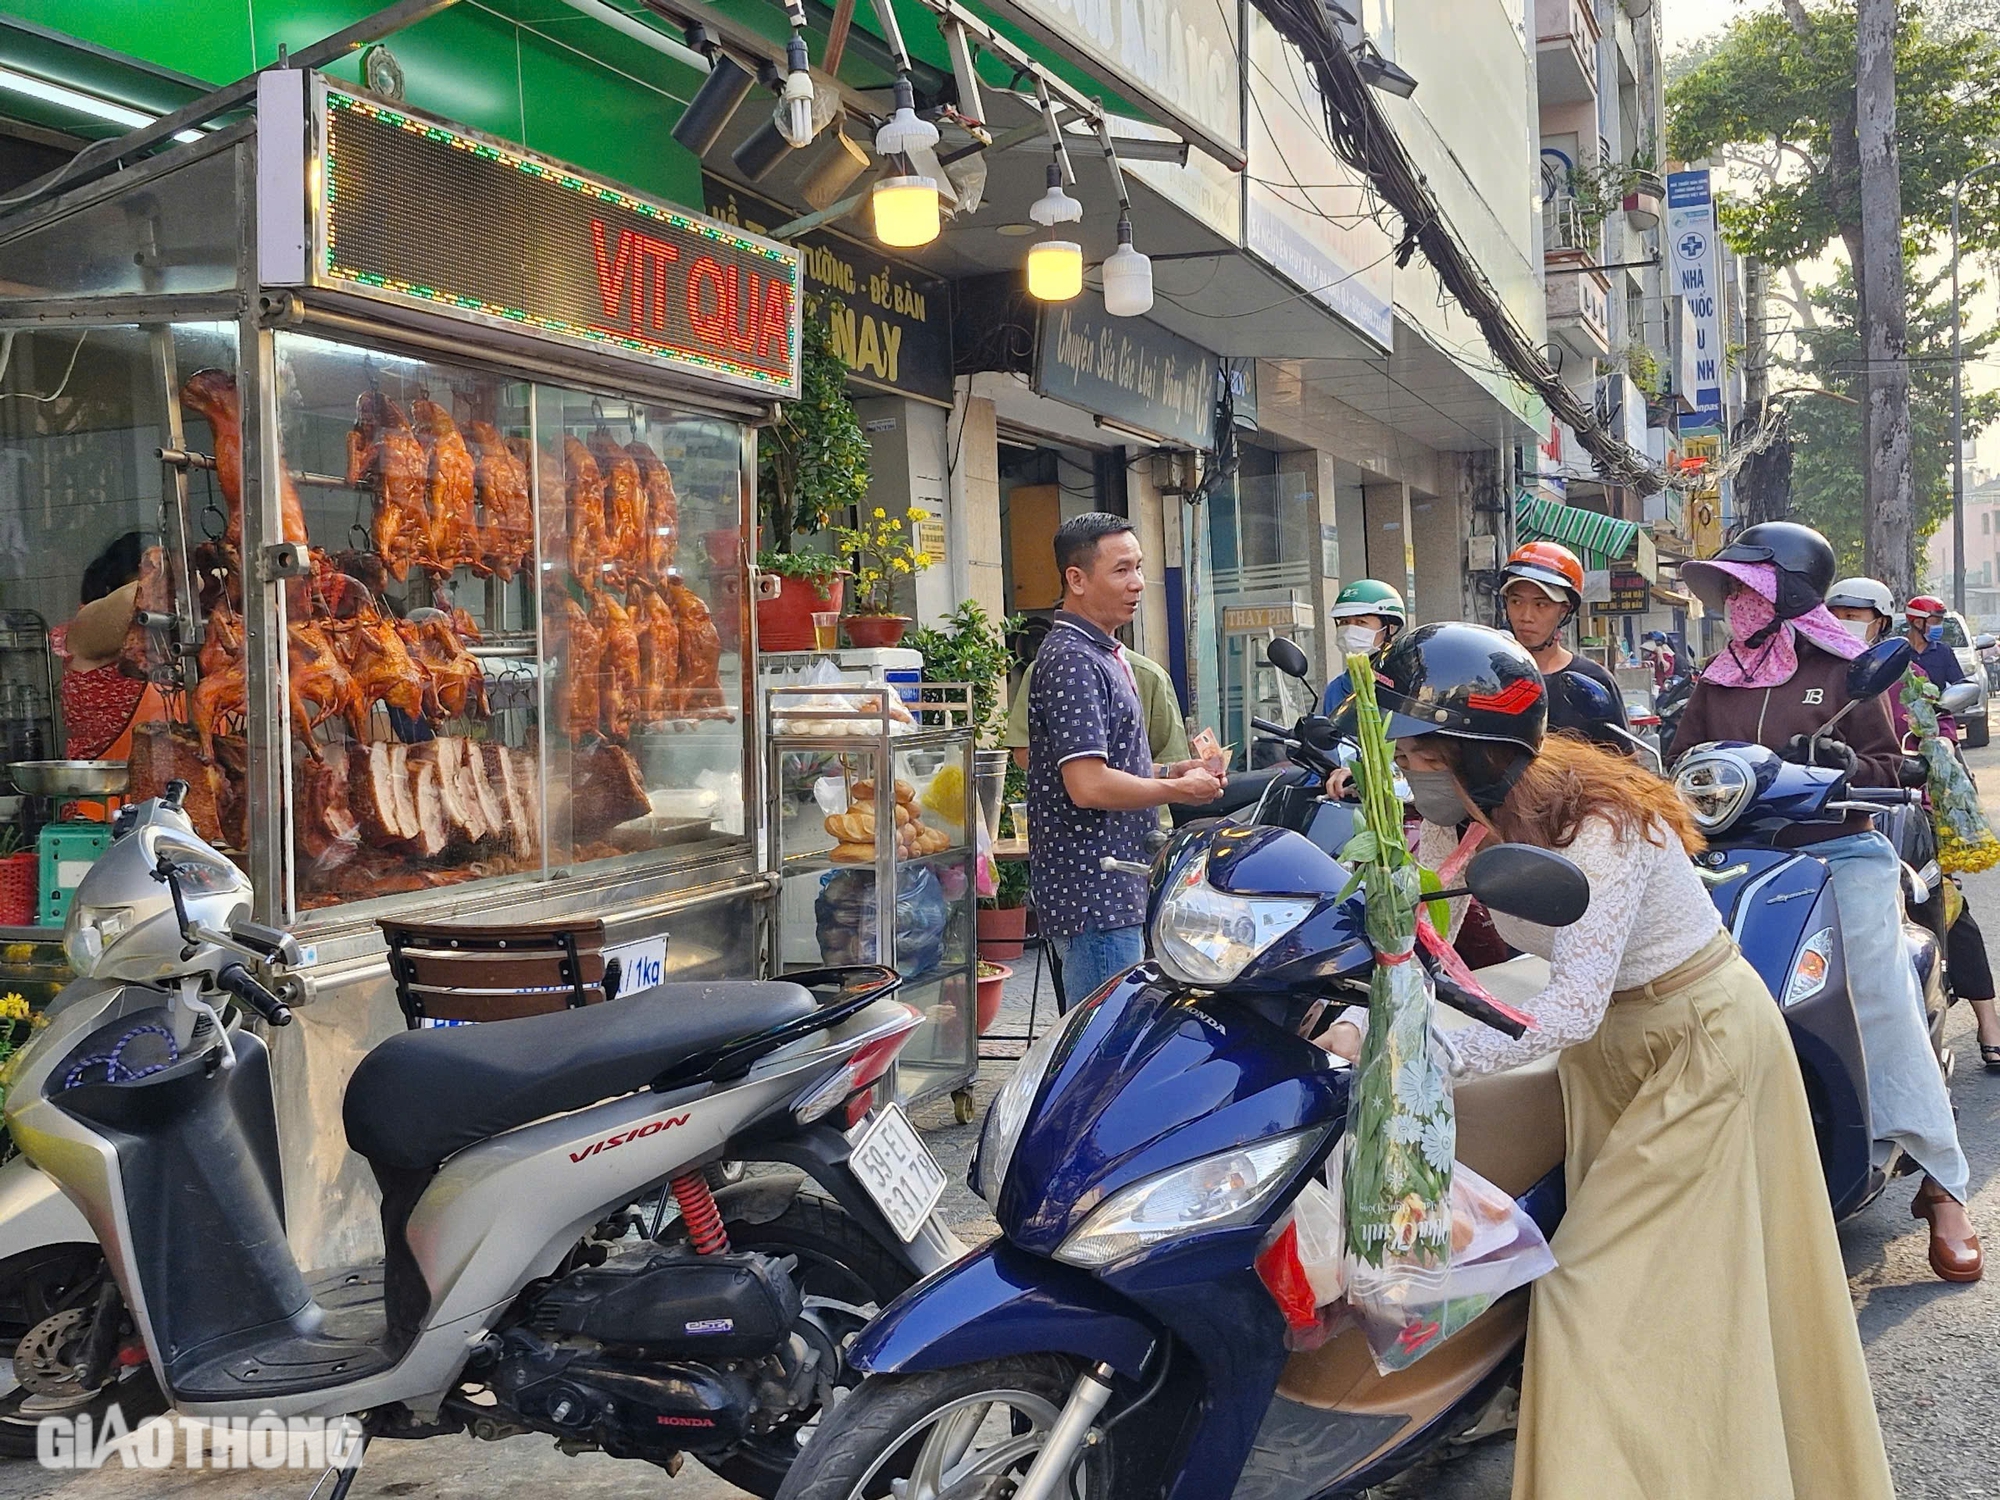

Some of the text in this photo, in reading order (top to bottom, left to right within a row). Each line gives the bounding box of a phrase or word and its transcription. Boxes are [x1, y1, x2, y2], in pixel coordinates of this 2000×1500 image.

[870, 265, 892, 309] ĐỂ
[894, 281, 926, 323] BÀN
[1682, 264, 1704, 289] NHÀ
[831, 308, 901, 382] NAY
[1058, 308, 1094, 386] Chuyên
[1097, 326, 1115, 382] Sửa
[1119, 336, 1135, 391] Các
[1163, 353, 1182, 424] Đồng
[1228, 607, 1292, 626] THAY PIN
[1802, 688, 1824, 705] B
[636, 956, 661, 987] 1kg
[569, 1113, 691, 1163] VISION
[884, 1153, 939, 1231] 631.78
[657, 1415, 716, 1428] HONDA
